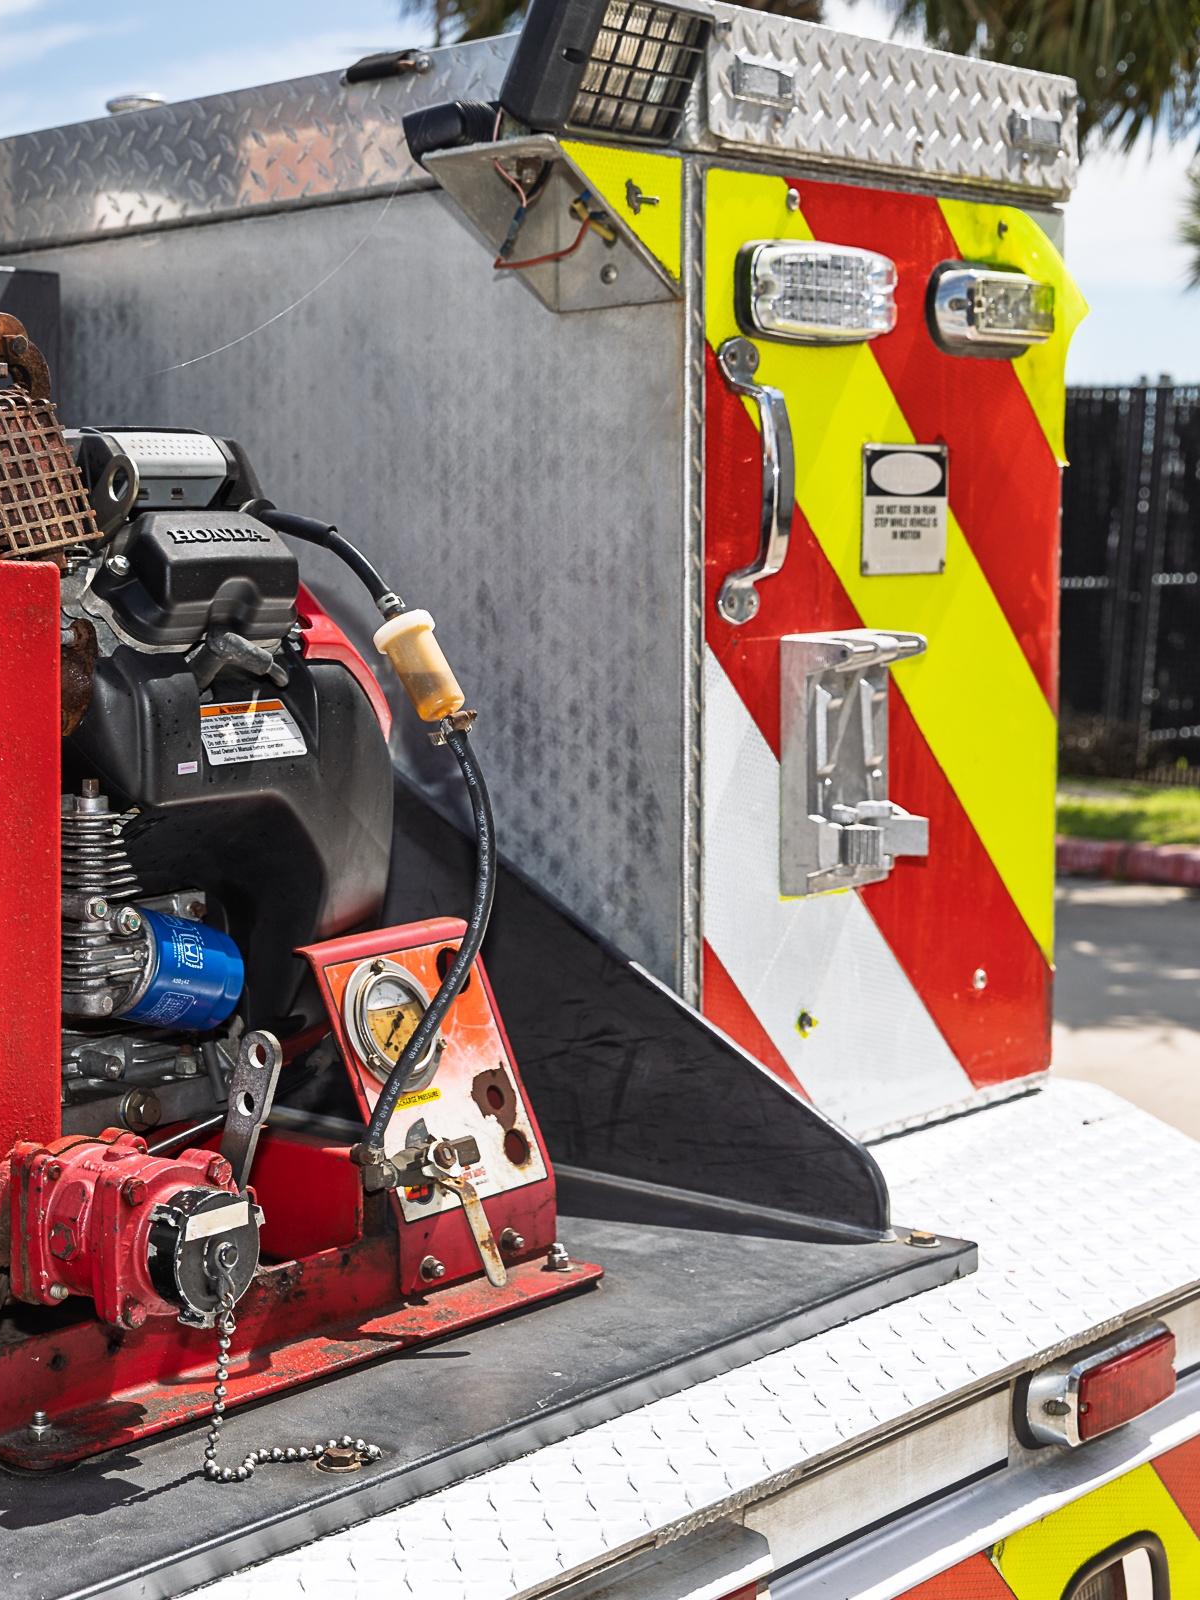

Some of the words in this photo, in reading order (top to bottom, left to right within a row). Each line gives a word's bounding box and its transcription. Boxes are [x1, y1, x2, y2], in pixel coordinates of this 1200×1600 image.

[166, 528, 271, 544] HONDA
[238, 744, 253, 752] Manual
[372, 1121, 383, 1138] SAE
